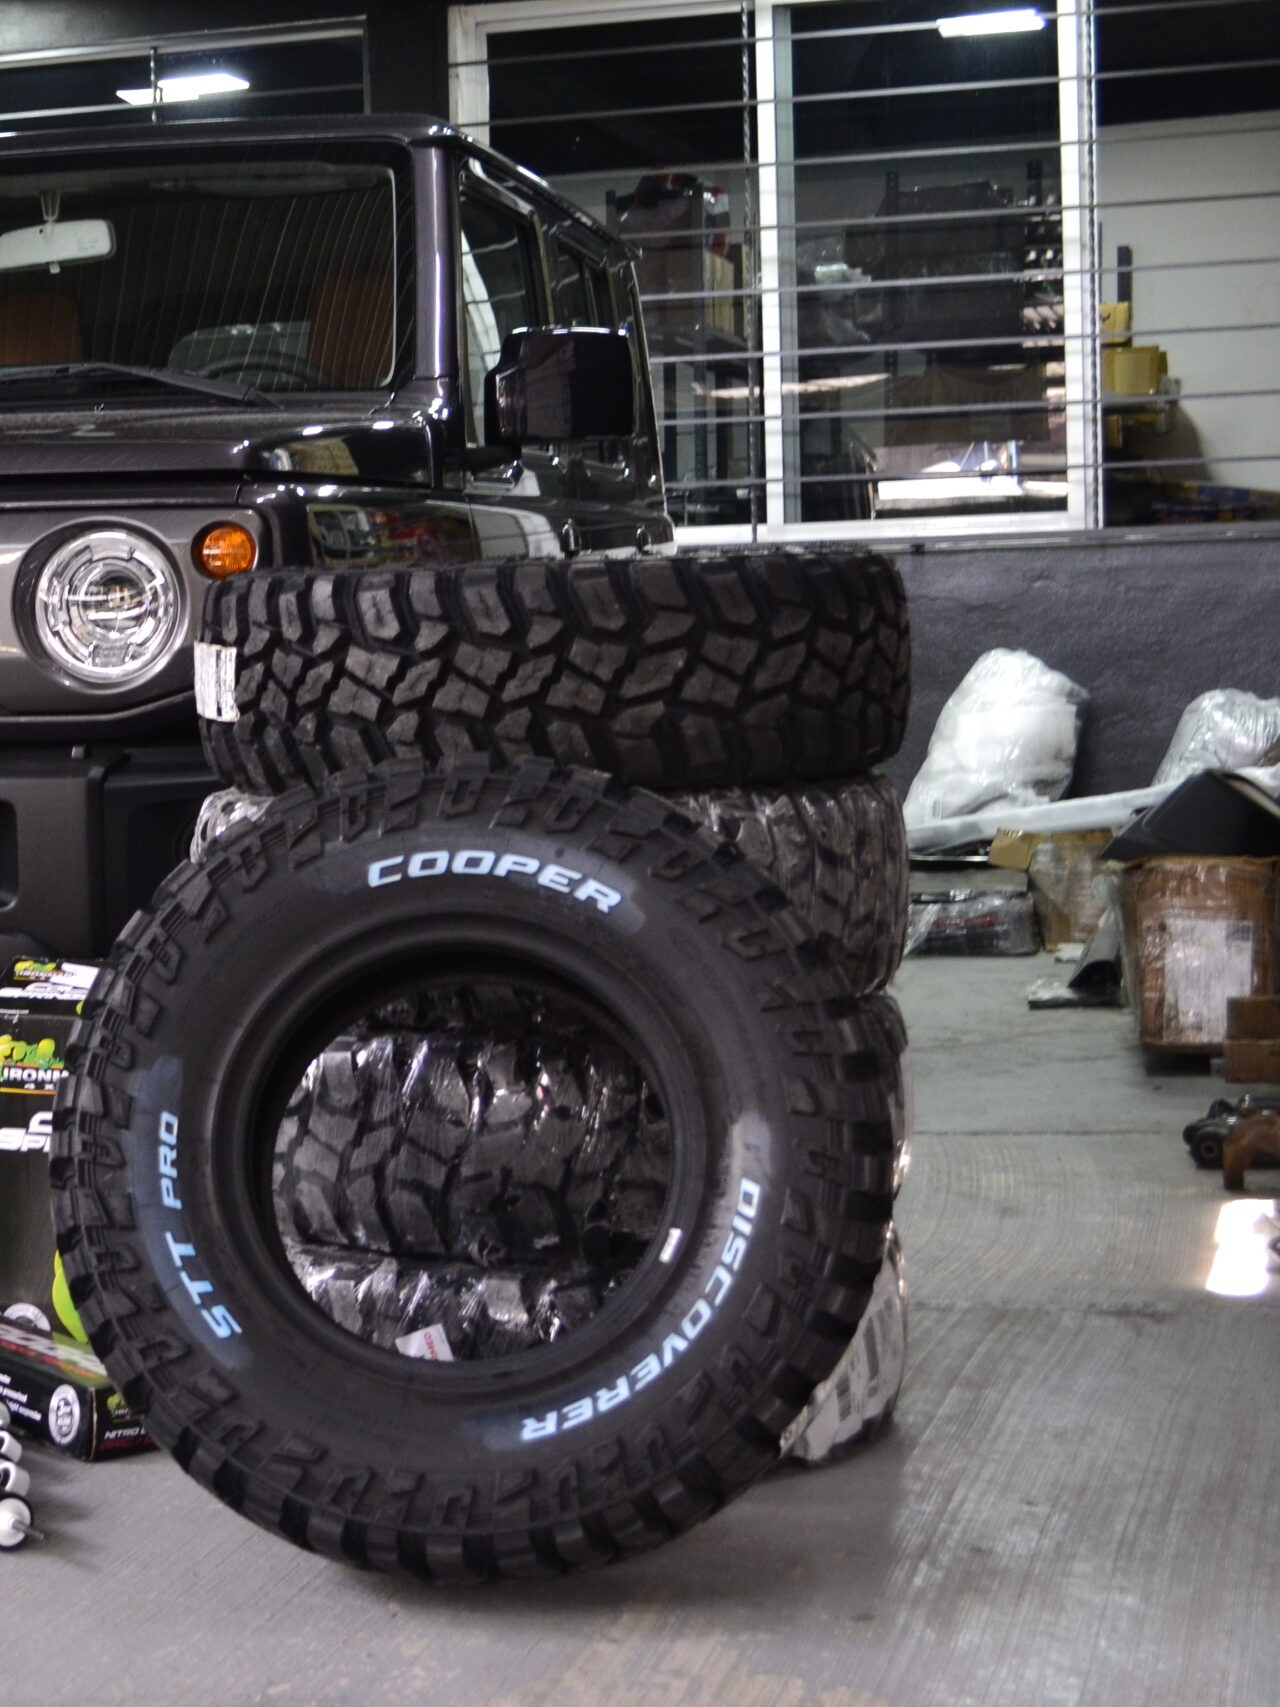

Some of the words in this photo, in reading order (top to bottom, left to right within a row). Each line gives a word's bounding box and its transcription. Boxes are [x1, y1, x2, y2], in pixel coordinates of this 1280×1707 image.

[367, 850, 625, 914] COOPER
[158, 1110, 183, 1210] PRO
[164, 1231, 243, 1339] STT
[520, 1178, 761, 1443] DISCOVERER
